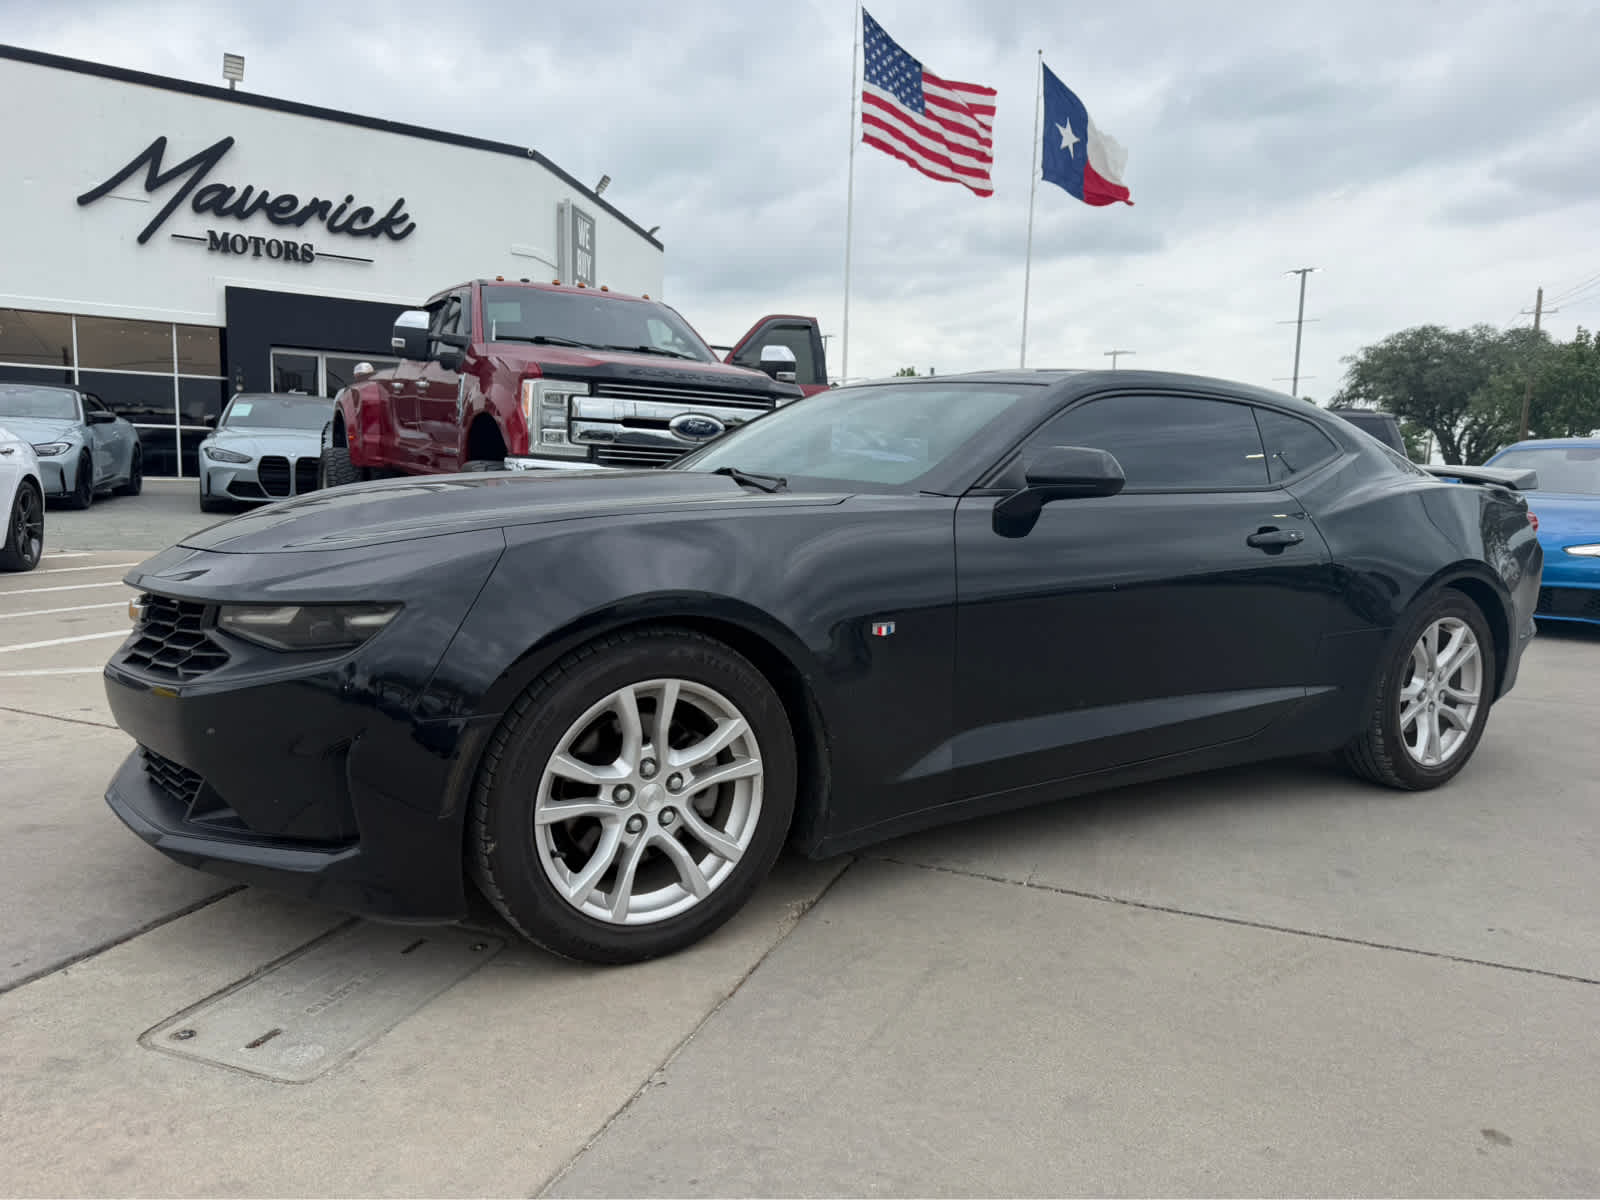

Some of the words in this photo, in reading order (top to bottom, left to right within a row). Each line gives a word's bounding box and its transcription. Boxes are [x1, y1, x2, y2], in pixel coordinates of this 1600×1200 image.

[77, 136, 416, 245] Maverick
[207, 229, 315, 263] MOTORS
[577, 216, 591, 250] WE
[577, 249, 592, 281] BUY
